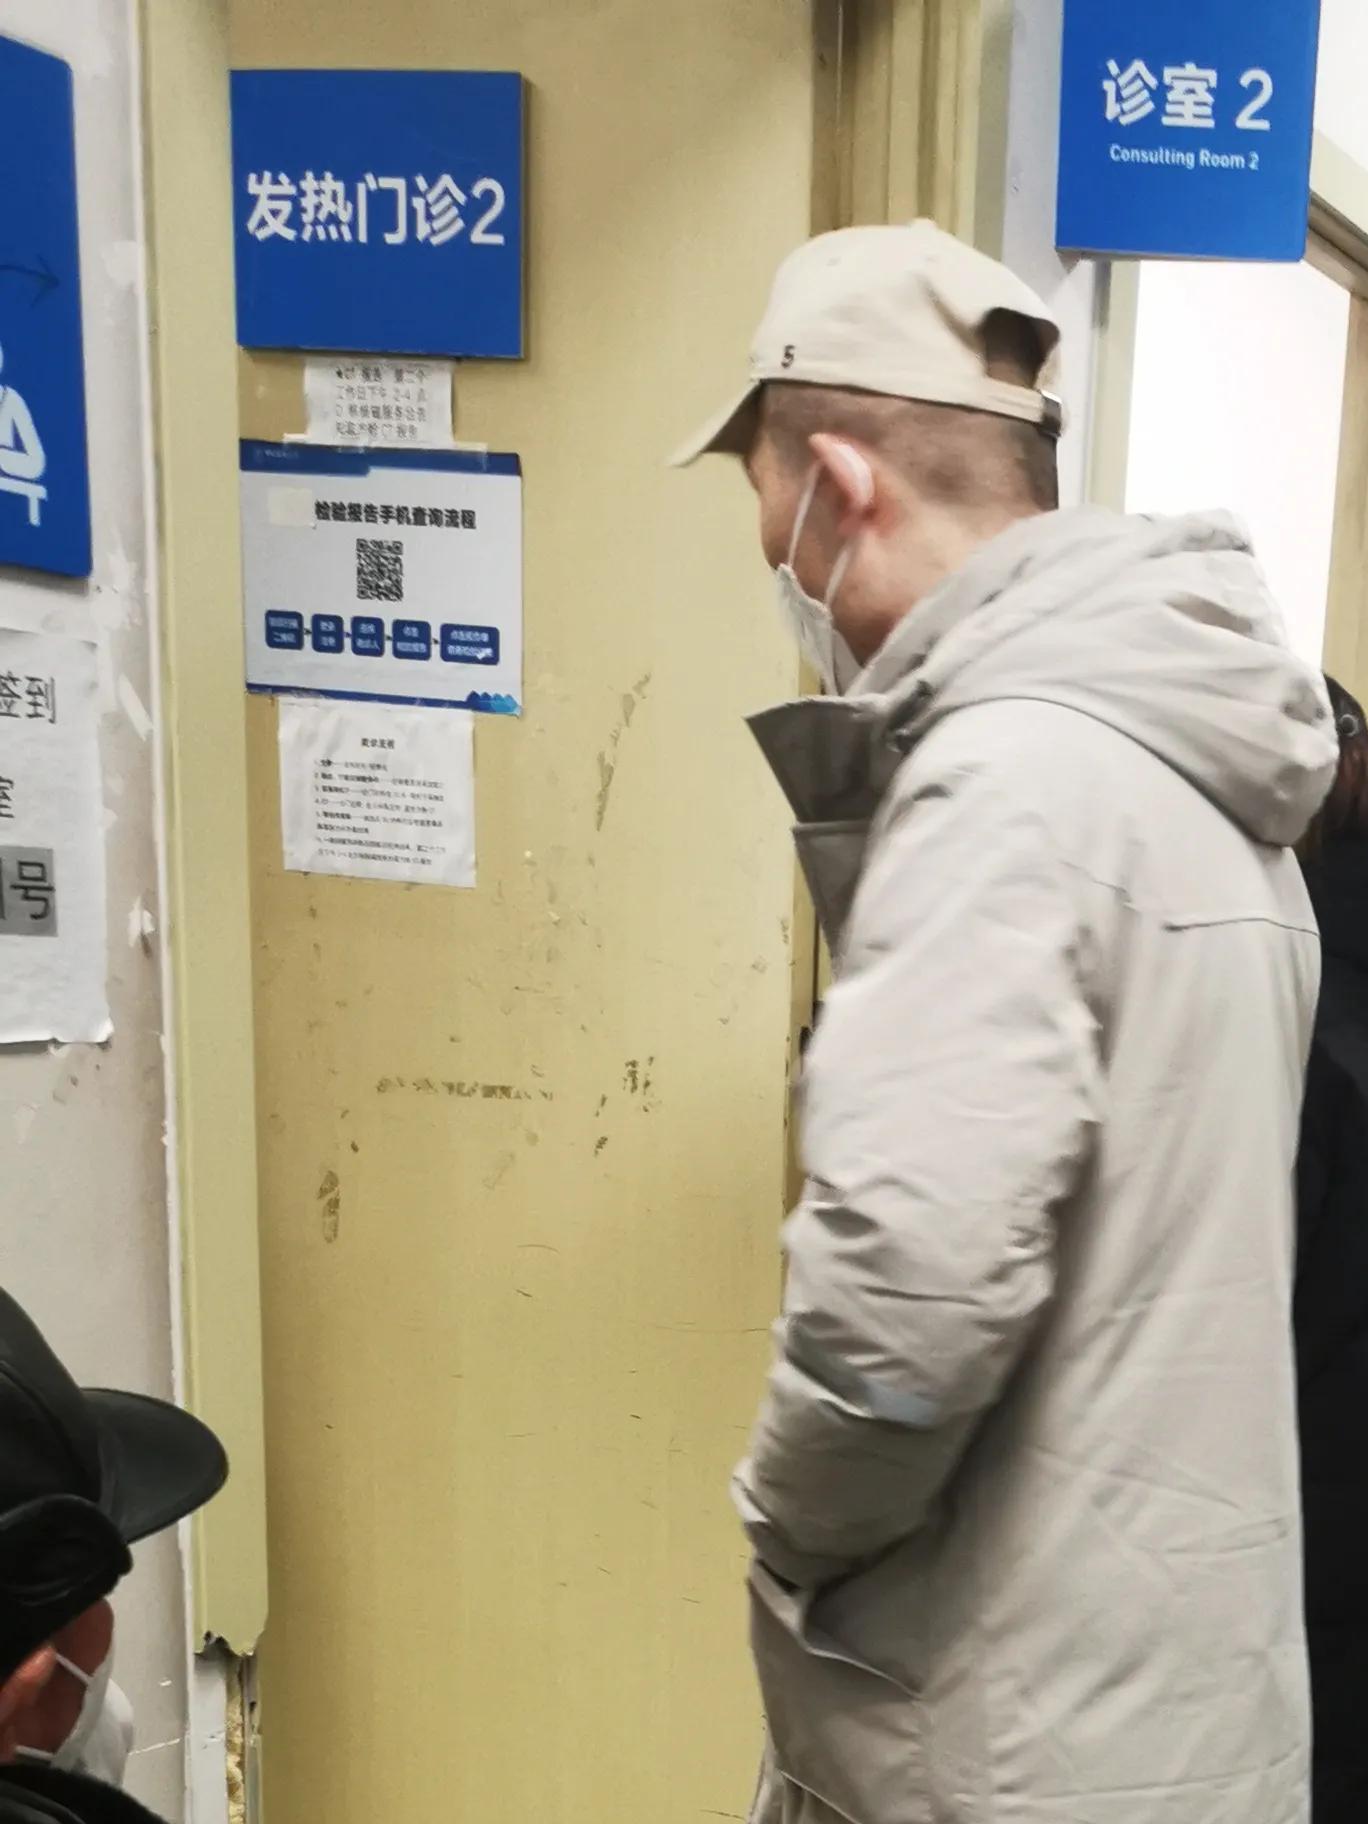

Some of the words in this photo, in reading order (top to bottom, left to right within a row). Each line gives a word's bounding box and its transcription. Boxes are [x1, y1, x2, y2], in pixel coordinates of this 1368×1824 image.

[1102, 58, 1218, 127] 诊室
[1235, 69, 1274, 132] 2
[1110, 143, 1196, 171] Consulting
[1199, 148, 1246, 169] Room
[1249, 151, 1260, 171] 2
[247, 170, 505, 246] 发热门诊2
